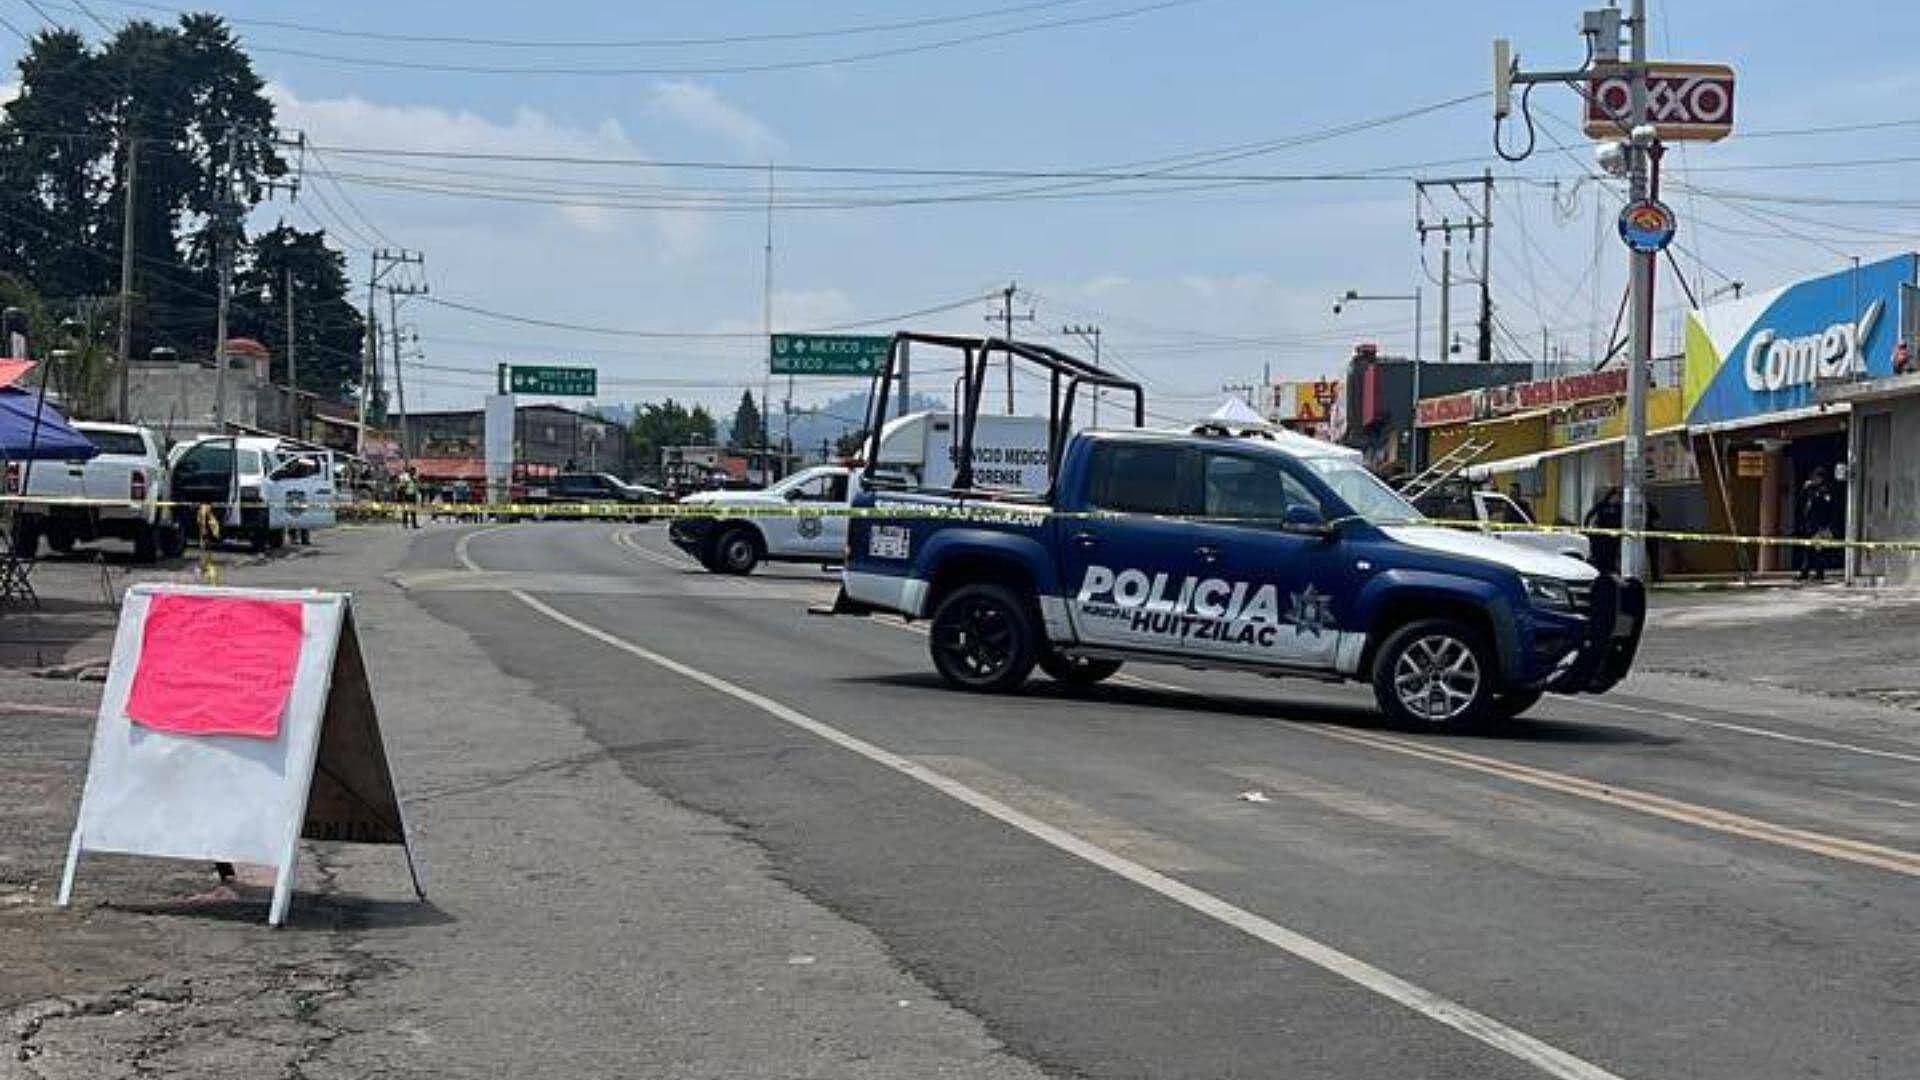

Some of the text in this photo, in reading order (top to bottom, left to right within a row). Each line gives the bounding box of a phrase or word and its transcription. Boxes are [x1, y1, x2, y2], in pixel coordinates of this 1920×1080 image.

[1597, 78, 1728, 121] OXXO
[1745, 299, 1885, 391] Comex
[948, 445, 1047, 466] SVICIO MEDICO
[1076, 565, 1279, 625] POLICIA
[1130, 609, 1279, 648] HUITZILAC
